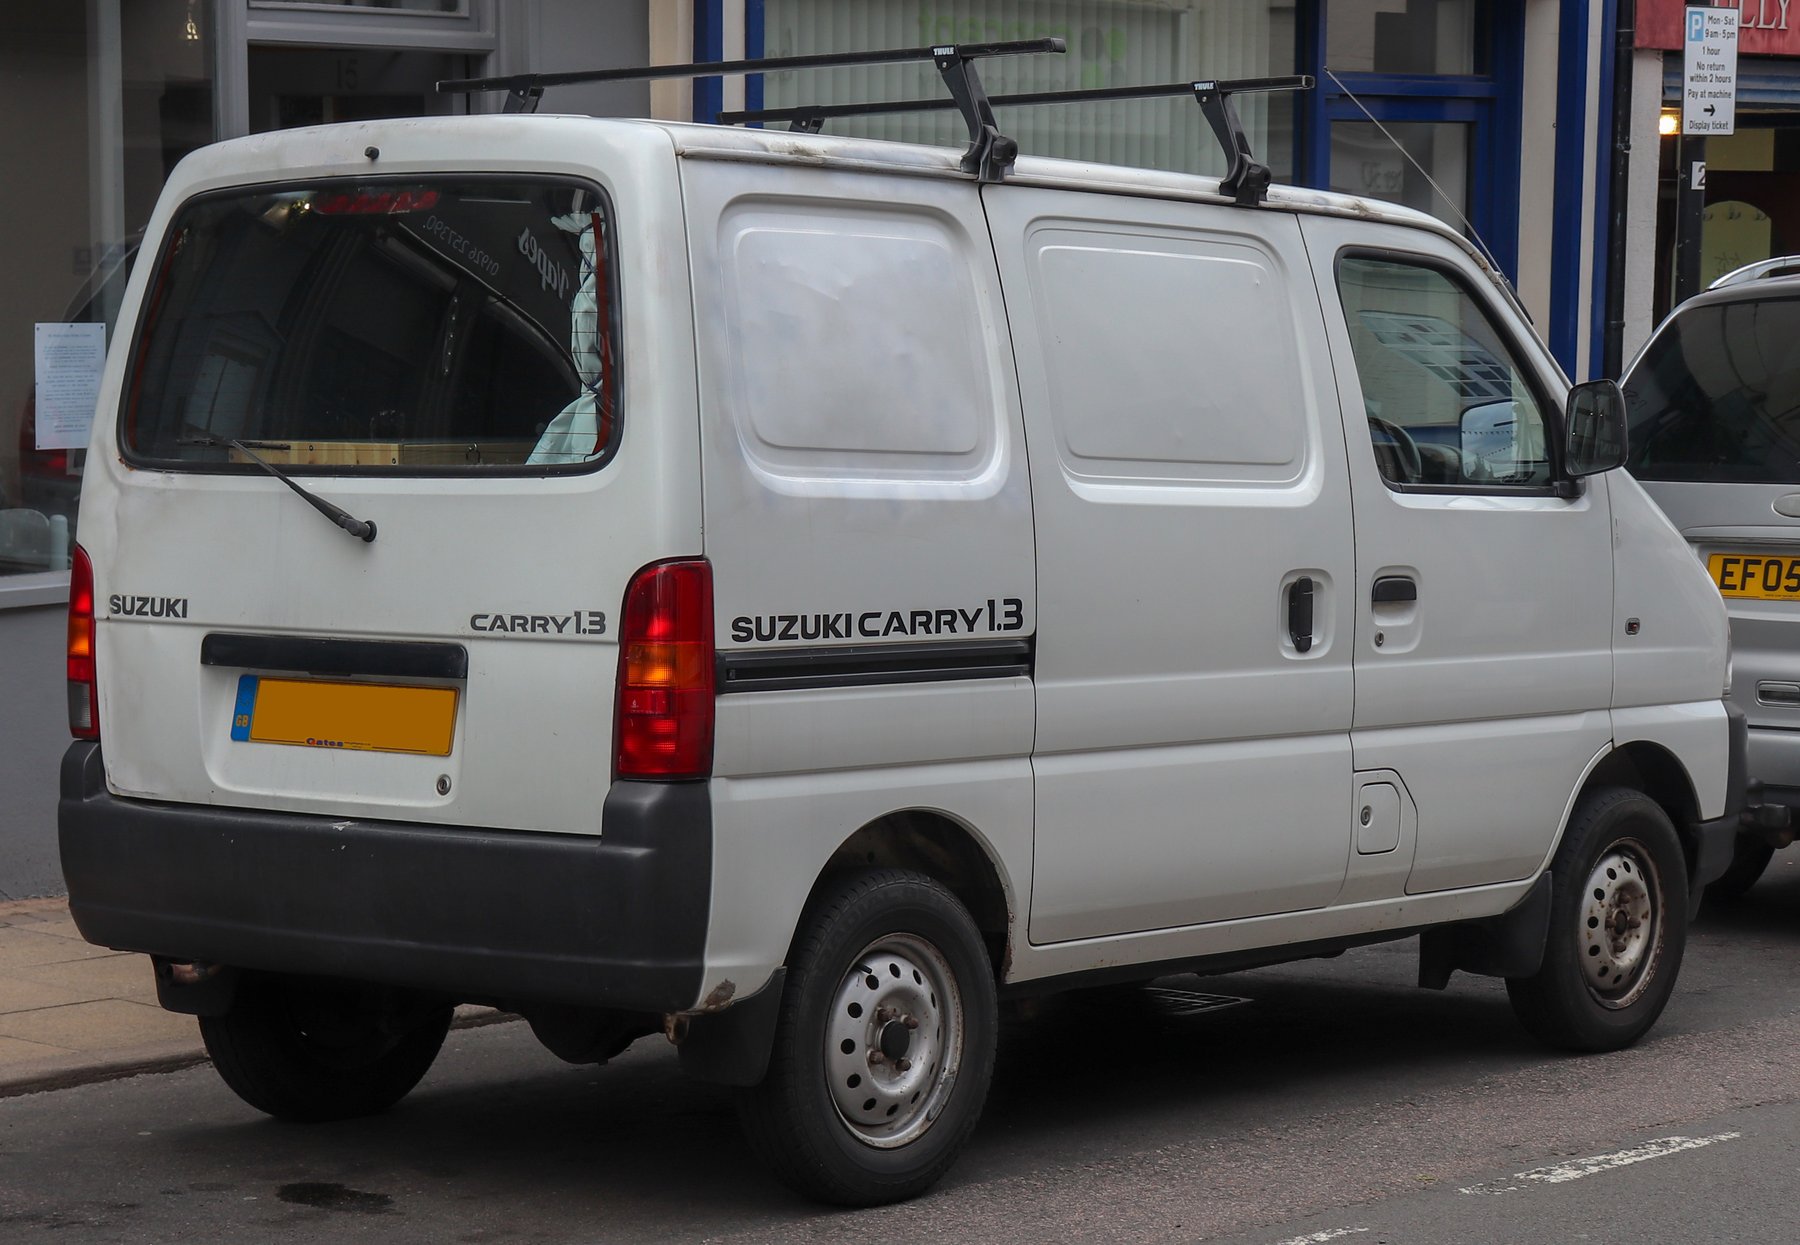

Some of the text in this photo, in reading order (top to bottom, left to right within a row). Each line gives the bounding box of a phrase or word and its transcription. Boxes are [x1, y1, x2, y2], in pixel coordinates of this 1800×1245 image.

[1713, 0, 1790, 29] LLY
[1691, 14, 1703, 39] P
[933, 47, 955, 56] THULE
[1706, 46, 1721, 55] hour
[1696, 61, 1725, 71] No return
[1689, 73, 1732, 83] within 2 hours
[1194, 82, 1215, 91] THULE
[1688, 89, 1732, 100] Pay at machine
[1689, 120, 1729, 131] Display ticket
[1719, 558, 1800, 592] EF05
[109, 594, 188, 618] SUZUKI
[470, 611, 606, 634] CARRY 1.3
[731, 598, 1024, 643] SUZUKI CARRY 1.3
[235, 714, 249, 728] GB
